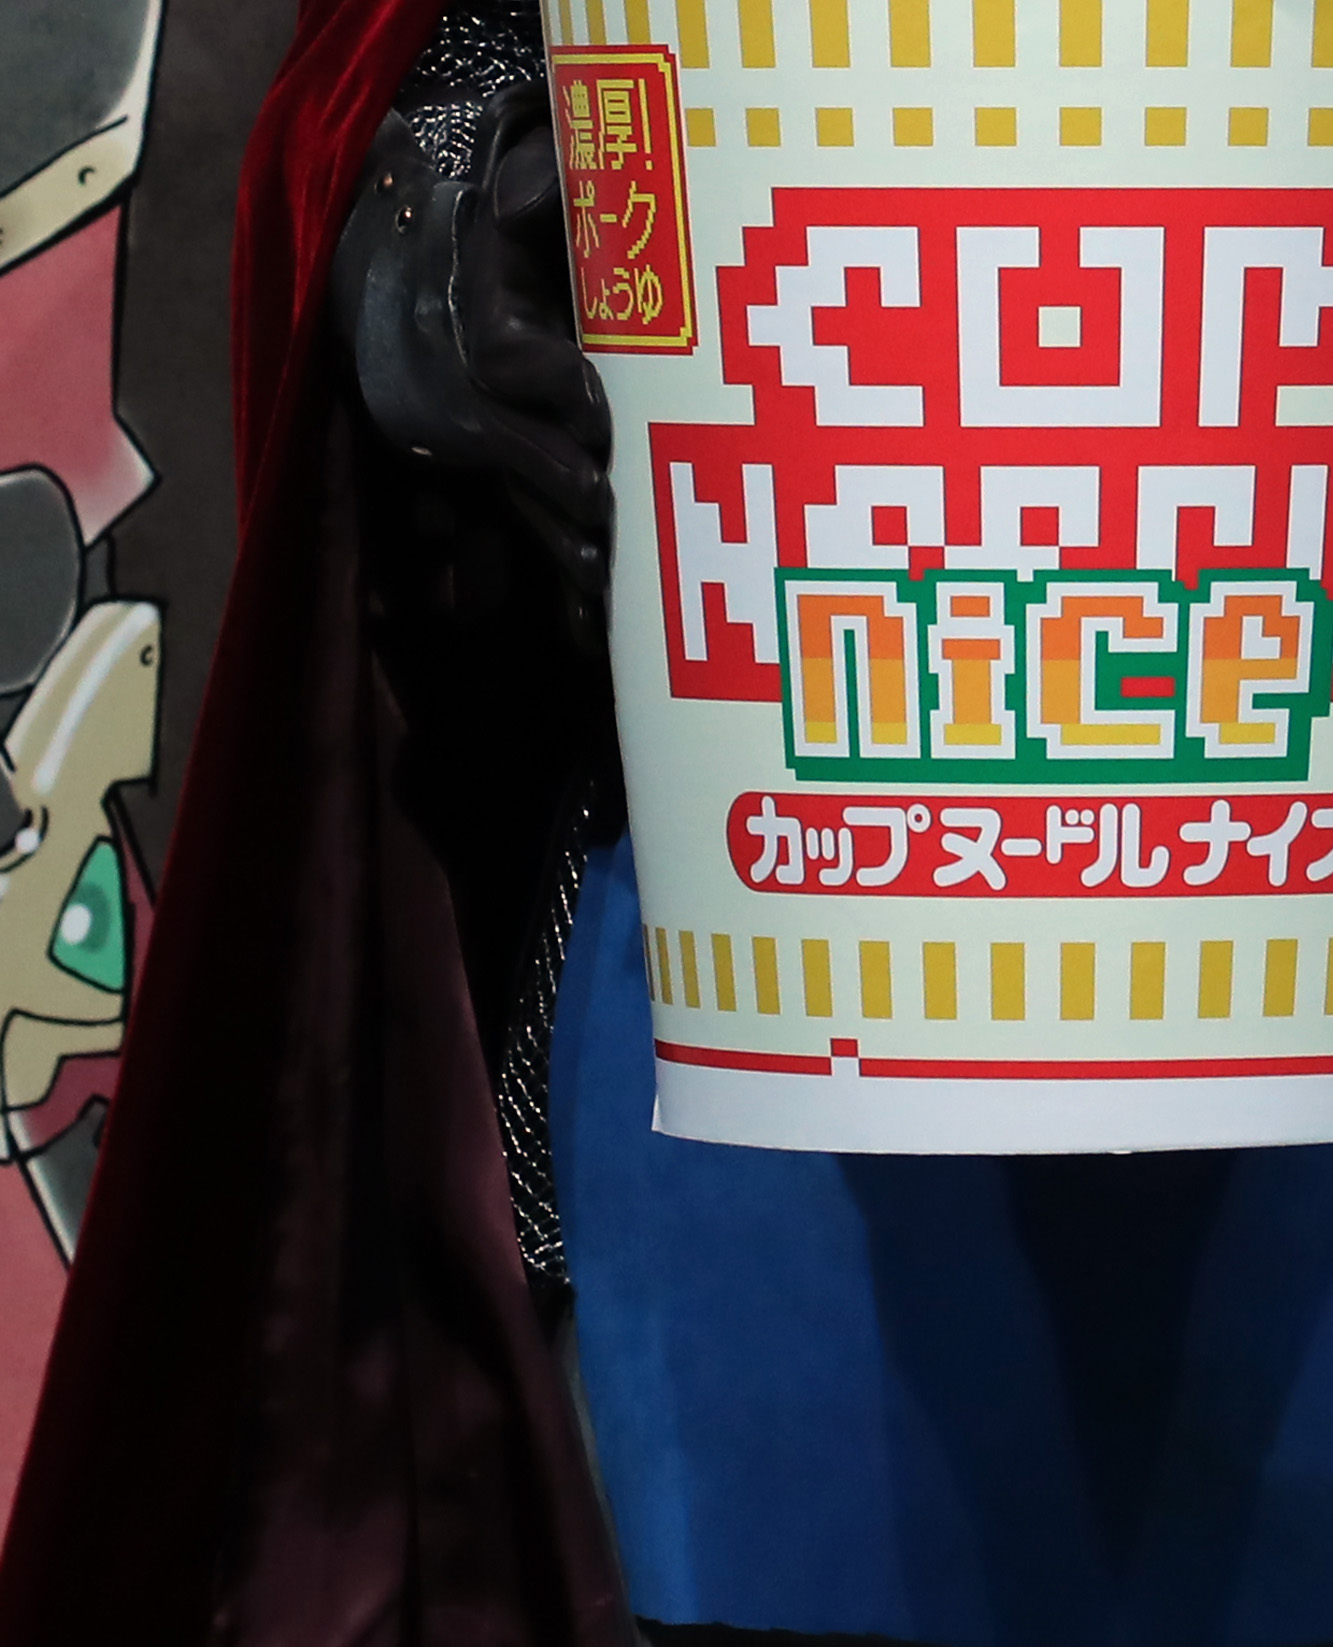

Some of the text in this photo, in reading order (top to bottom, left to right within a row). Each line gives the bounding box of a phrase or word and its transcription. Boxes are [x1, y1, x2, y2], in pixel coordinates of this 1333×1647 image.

[562, 78, 653, 171] 濃厚!
[571, 179, 658, 260] ポーク
[580, 262, 665, 326] しょうゆ
[783, 578, 1316, 760] nice
